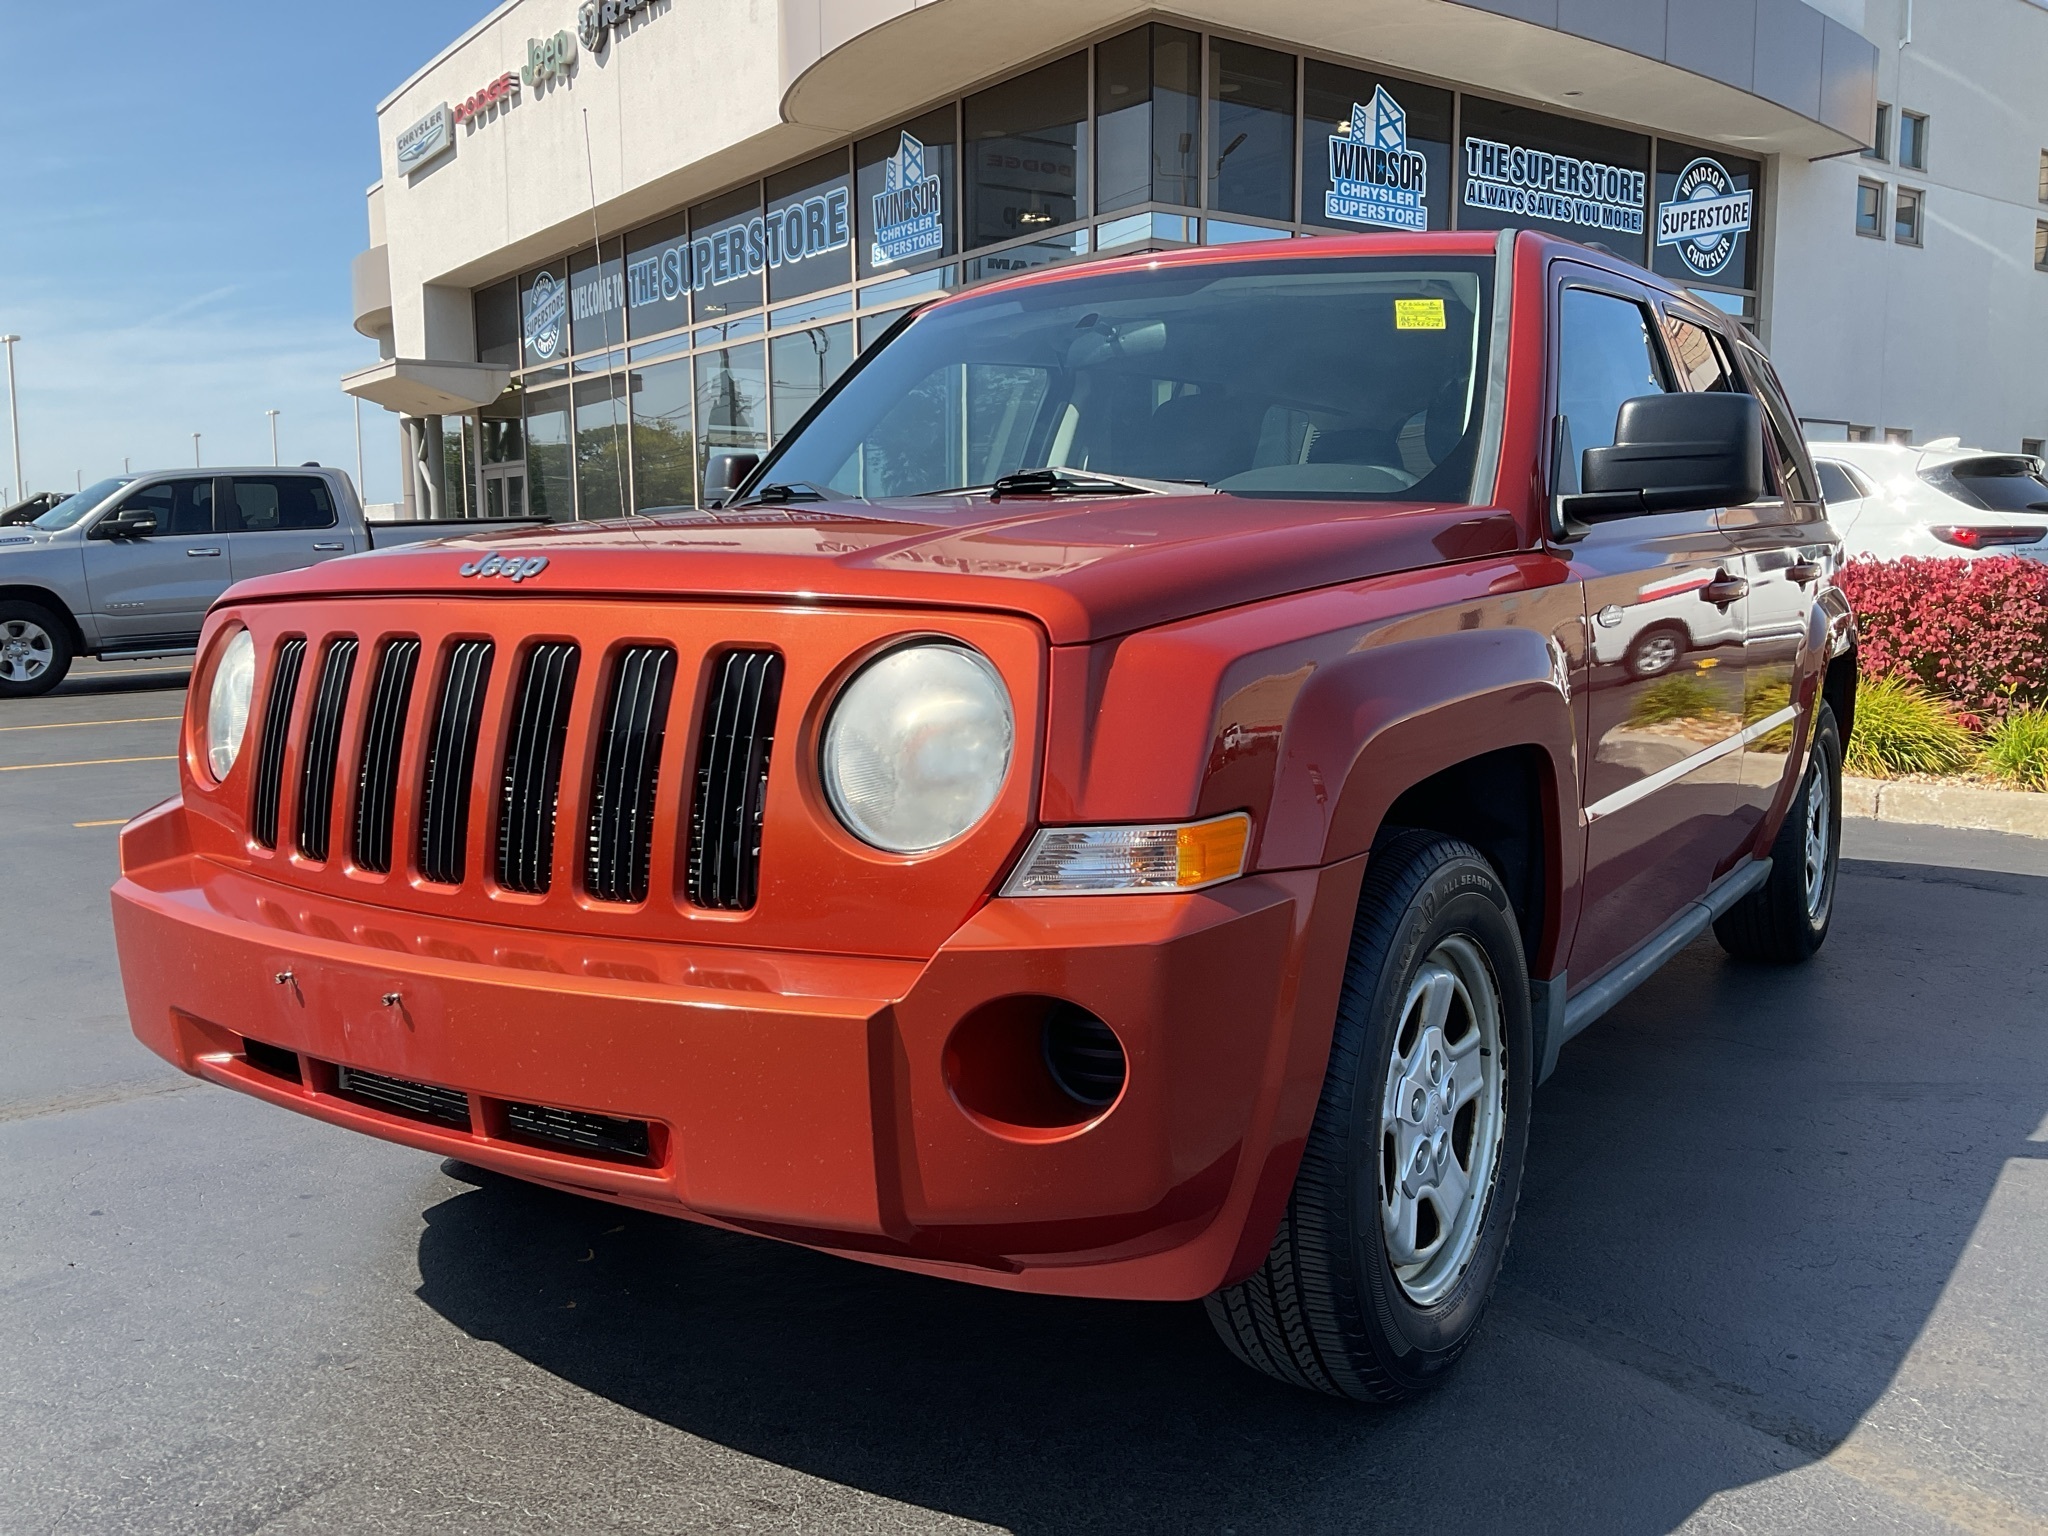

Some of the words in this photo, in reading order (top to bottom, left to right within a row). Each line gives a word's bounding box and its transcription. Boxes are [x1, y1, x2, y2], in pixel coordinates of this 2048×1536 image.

[602, 0, 652, 28] RA
[521, 30, 576, 87] Jeep
[454, 71, 519, 124] DODGE
[397, 110, 443, 151] CHRYSLER
[1332, 141, 1423, 192] WINDSOR
[1466, 138, 1509, 182] THE
[1511, 148, 1645, 207] SUPERSTORE
[1681, 166, 1726, 196] WINDSOR
[874, 179, 938, 230] WINDSOR
[1340, 182, 1414, 206] CHRYSLER
[1466, 180, 1525, 212] ALWAYS
[1527, 190, 1574, 221] SAVES
[1574, 200, 1600, 226] YOU
[1601, 205, 1643, 232] MORE!
[1330, 198, 1424, 226] SUPERSTORE
[1662, 202, 1749, 235] SUPERSTORE
[874, 230, 939, 261] SUPERSTORE
[881, 217, 932, 242] CHRYSLER
[571, 277, 612, 321] WELCOME
[612, 272, 624, 309] TO
[628, 258, 659, 307] THE
[662, 187, 848, 300] SUPERSTORE
[1687, 237, 1730, 269] CHRYSLER
[532, 278, 552, 305] WINDSOR
[526, 289, 564, 338] SUPERSTORE
[460, 551, 550, 583] Jeep
[1442, 878, 1458, 895] ALL
[1461, 874, 1493, 892] SEASON
